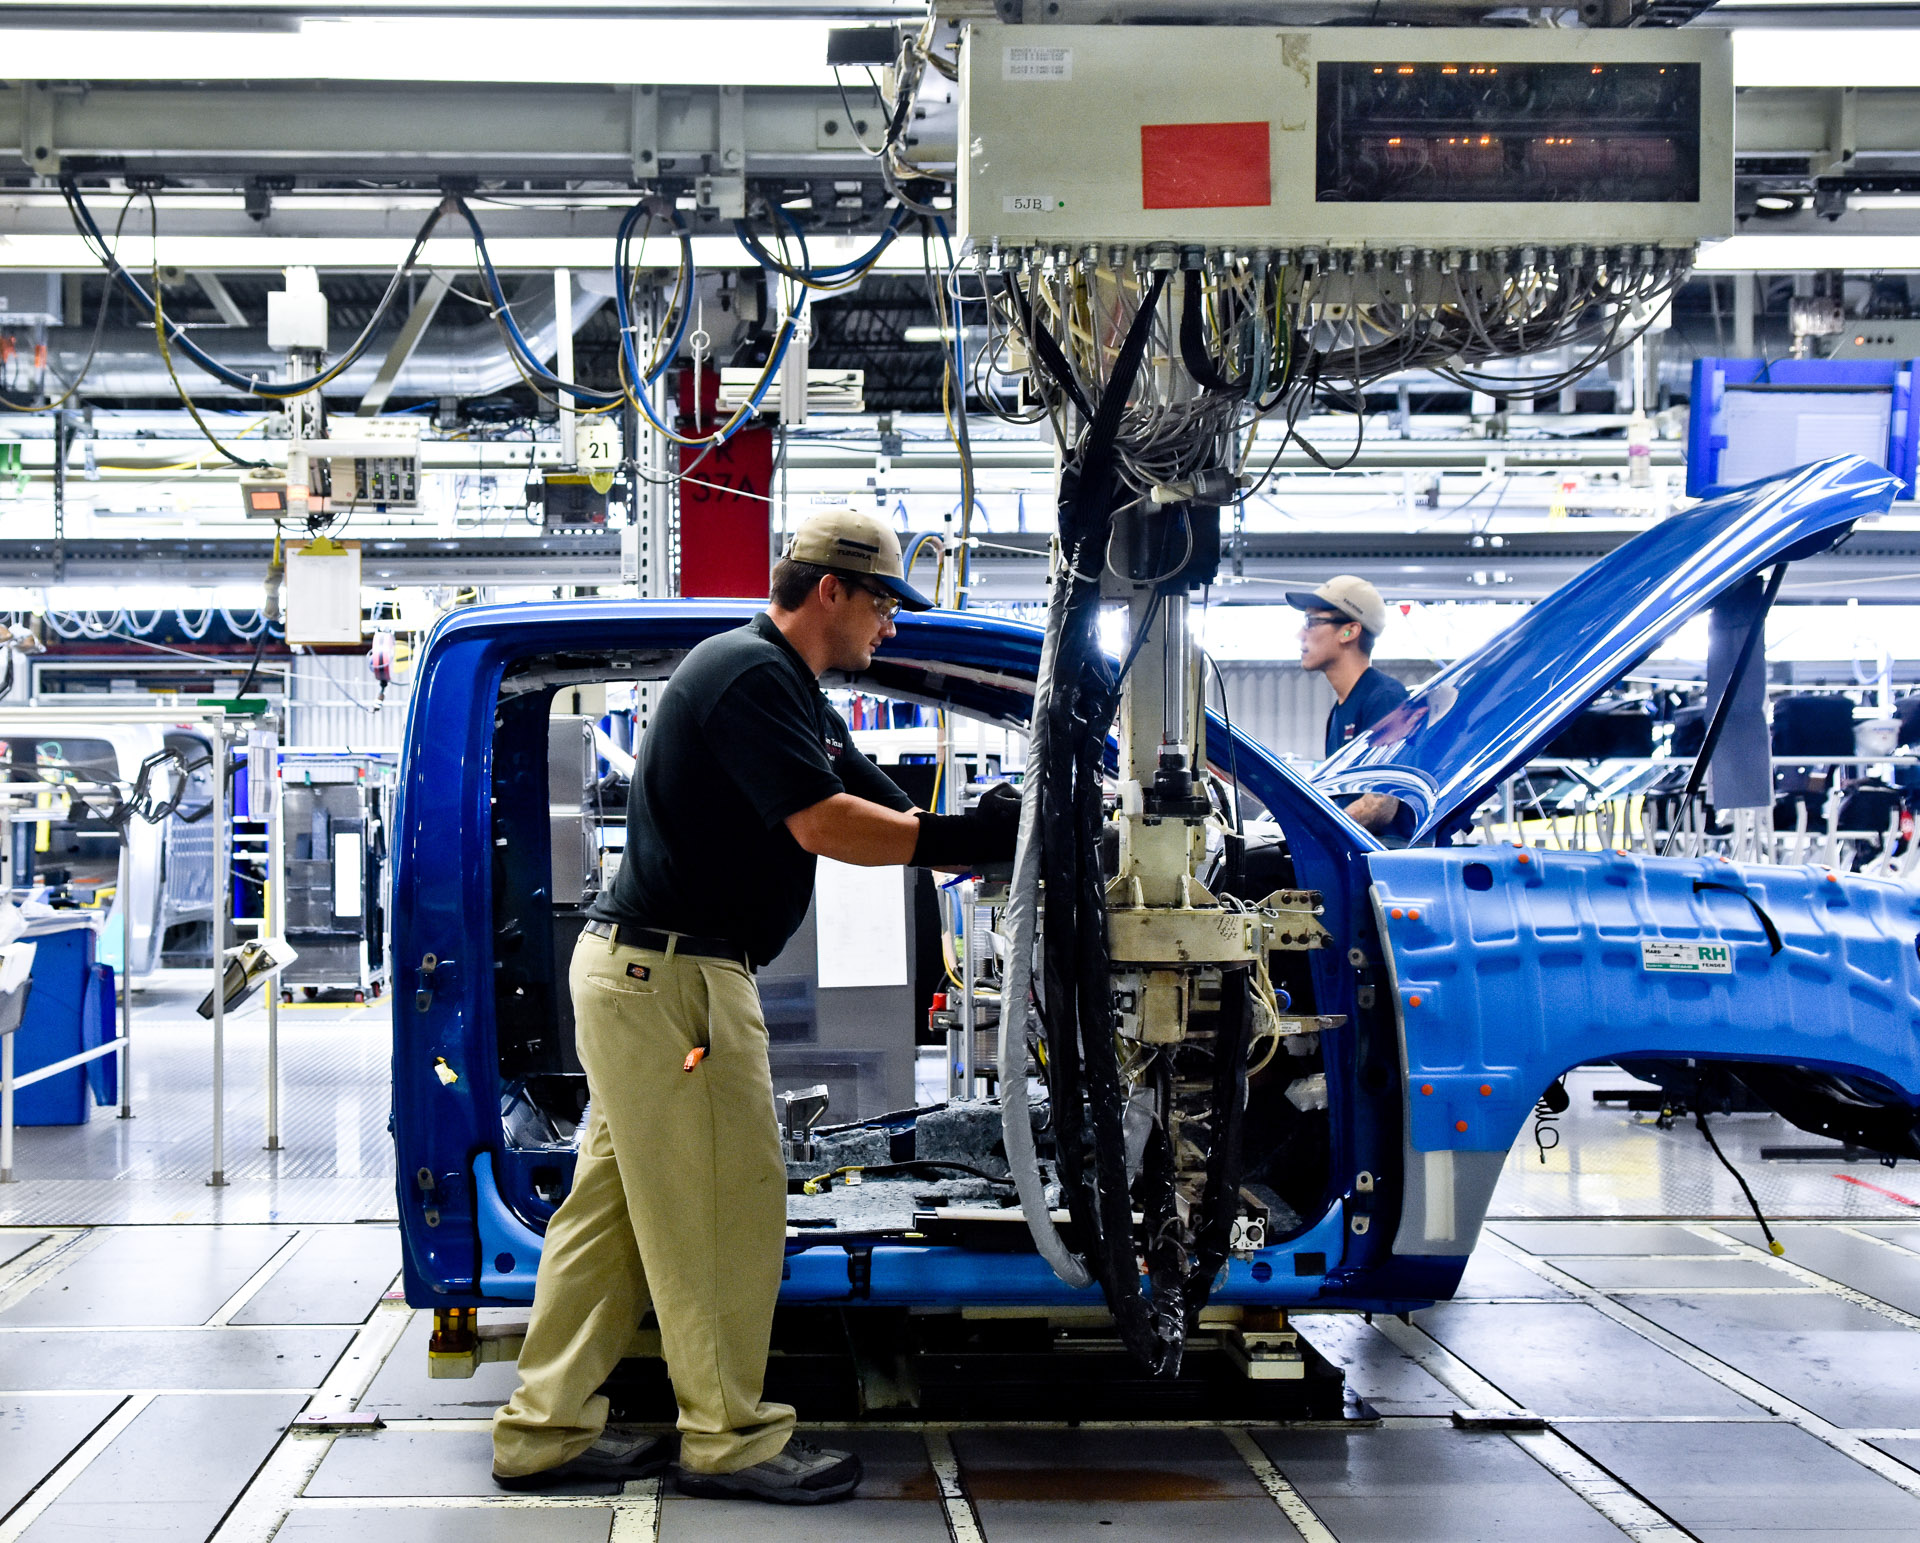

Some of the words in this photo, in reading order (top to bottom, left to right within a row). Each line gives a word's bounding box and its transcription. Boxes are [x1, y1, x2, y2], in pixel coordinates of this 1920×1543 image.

[1014, 198, 1042, 209] 5JB
[589, 442, 608, 459] 21
[692, 472, 759, 502] 37A
[1698, 946, 1727, 961] RH
